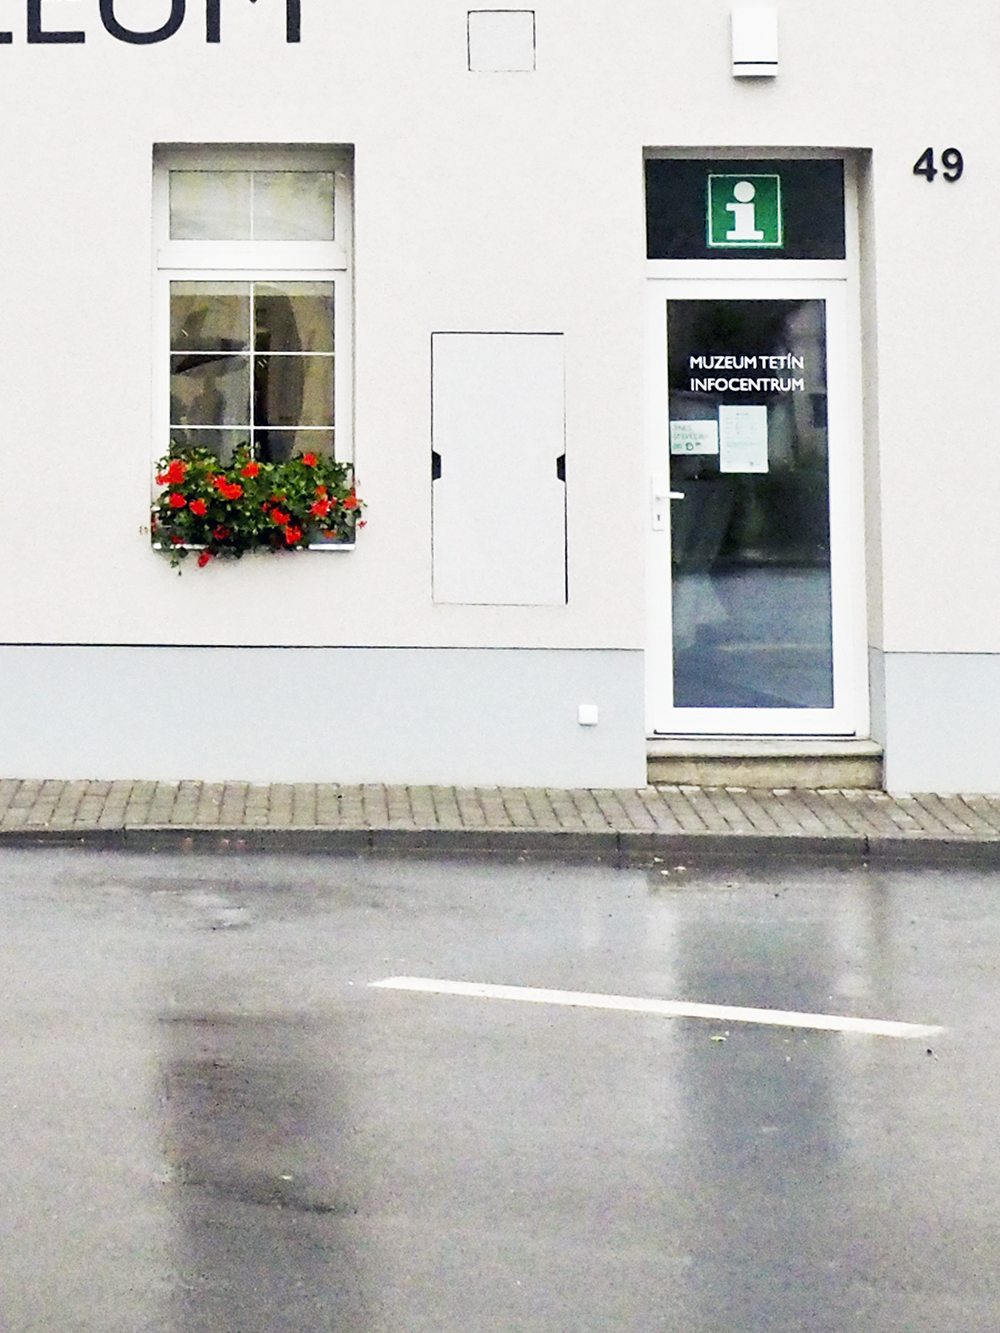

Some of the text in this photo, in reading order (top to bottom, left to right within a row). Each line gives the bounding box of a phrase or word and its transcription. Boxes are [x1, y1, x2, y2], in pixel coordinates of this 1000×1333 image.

[913, 147, 964, 183] 49
[689, 352, 805, 370] MUZEUM TETÍN
[690, 377, 805, 392] INFOCENTRUM
